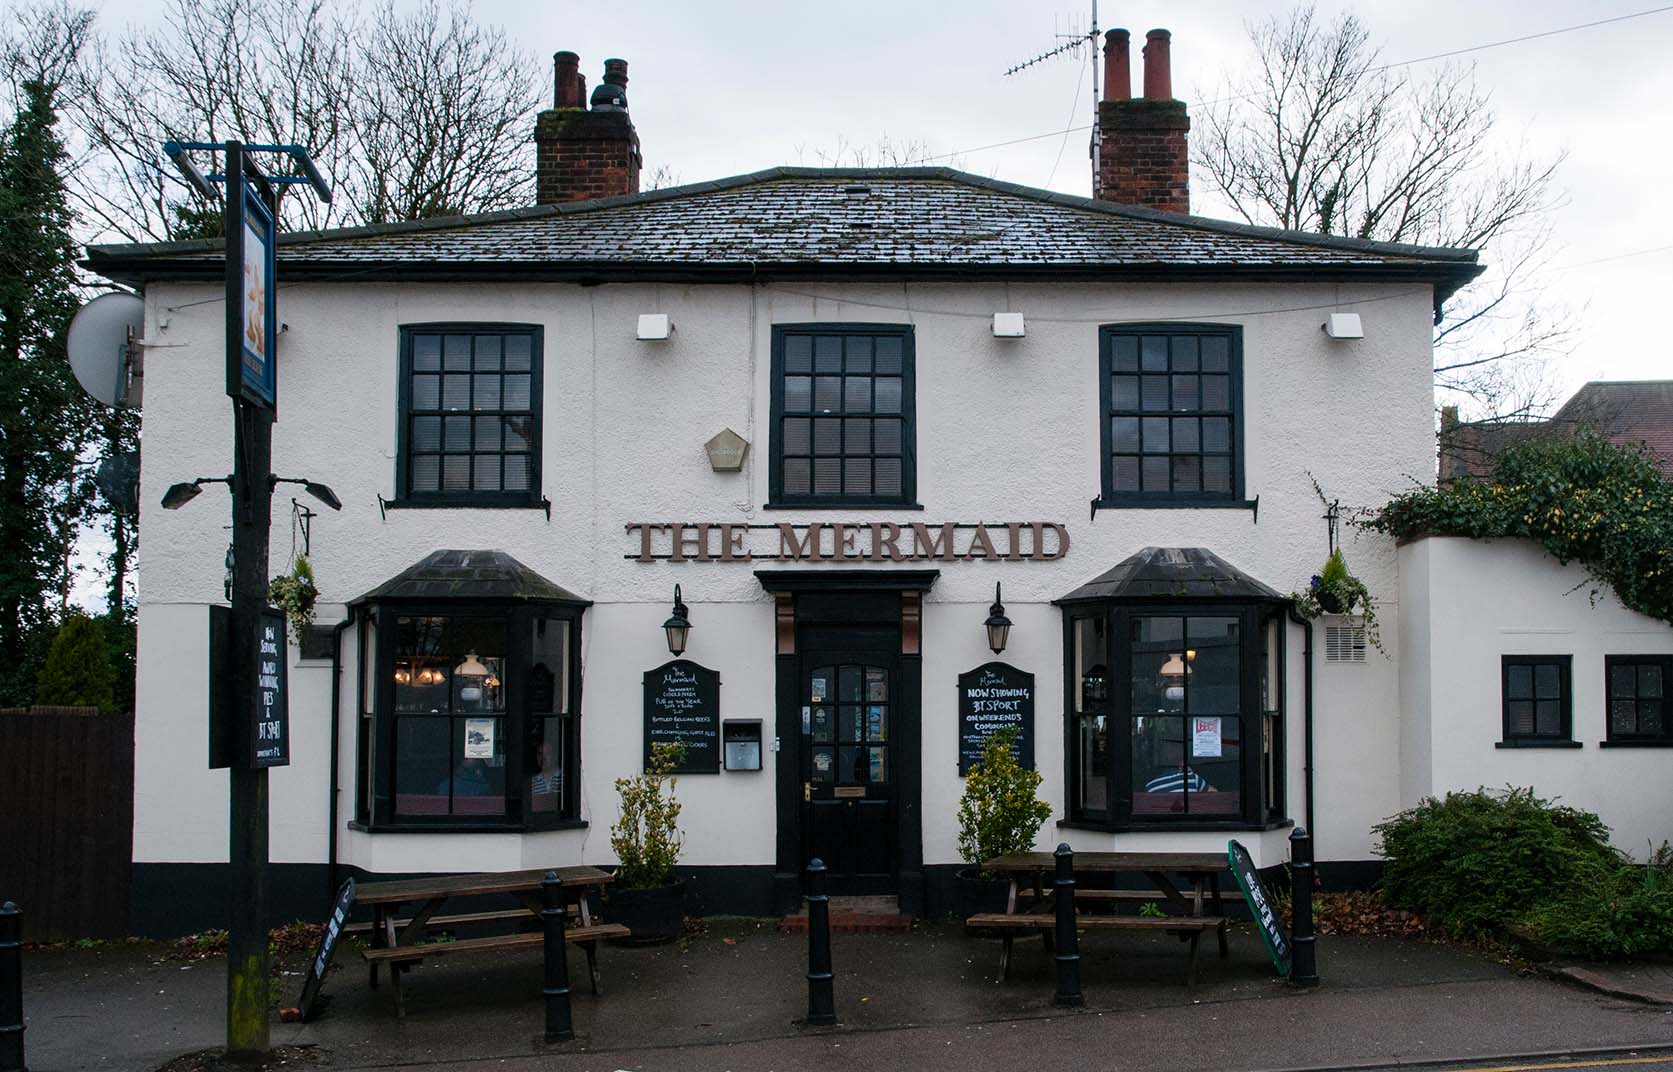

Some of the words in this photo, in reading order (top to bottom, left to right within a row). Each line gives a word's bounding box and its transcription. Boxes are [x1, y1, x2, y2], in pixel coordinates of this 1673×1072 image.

[626, 523, 752, 562] THE
[774, 521, 1070, 562] MERMAID
[662, 672, 699, 685] Mermaid
[967, 688, 990, 698] NOW
[990, 688, 1030, 700] SHOWING
[972, 700, 985, 713] BT
[986, 700, 1021, 711] SPORT
[978, 713, 1022, 721] WEEKENDS
